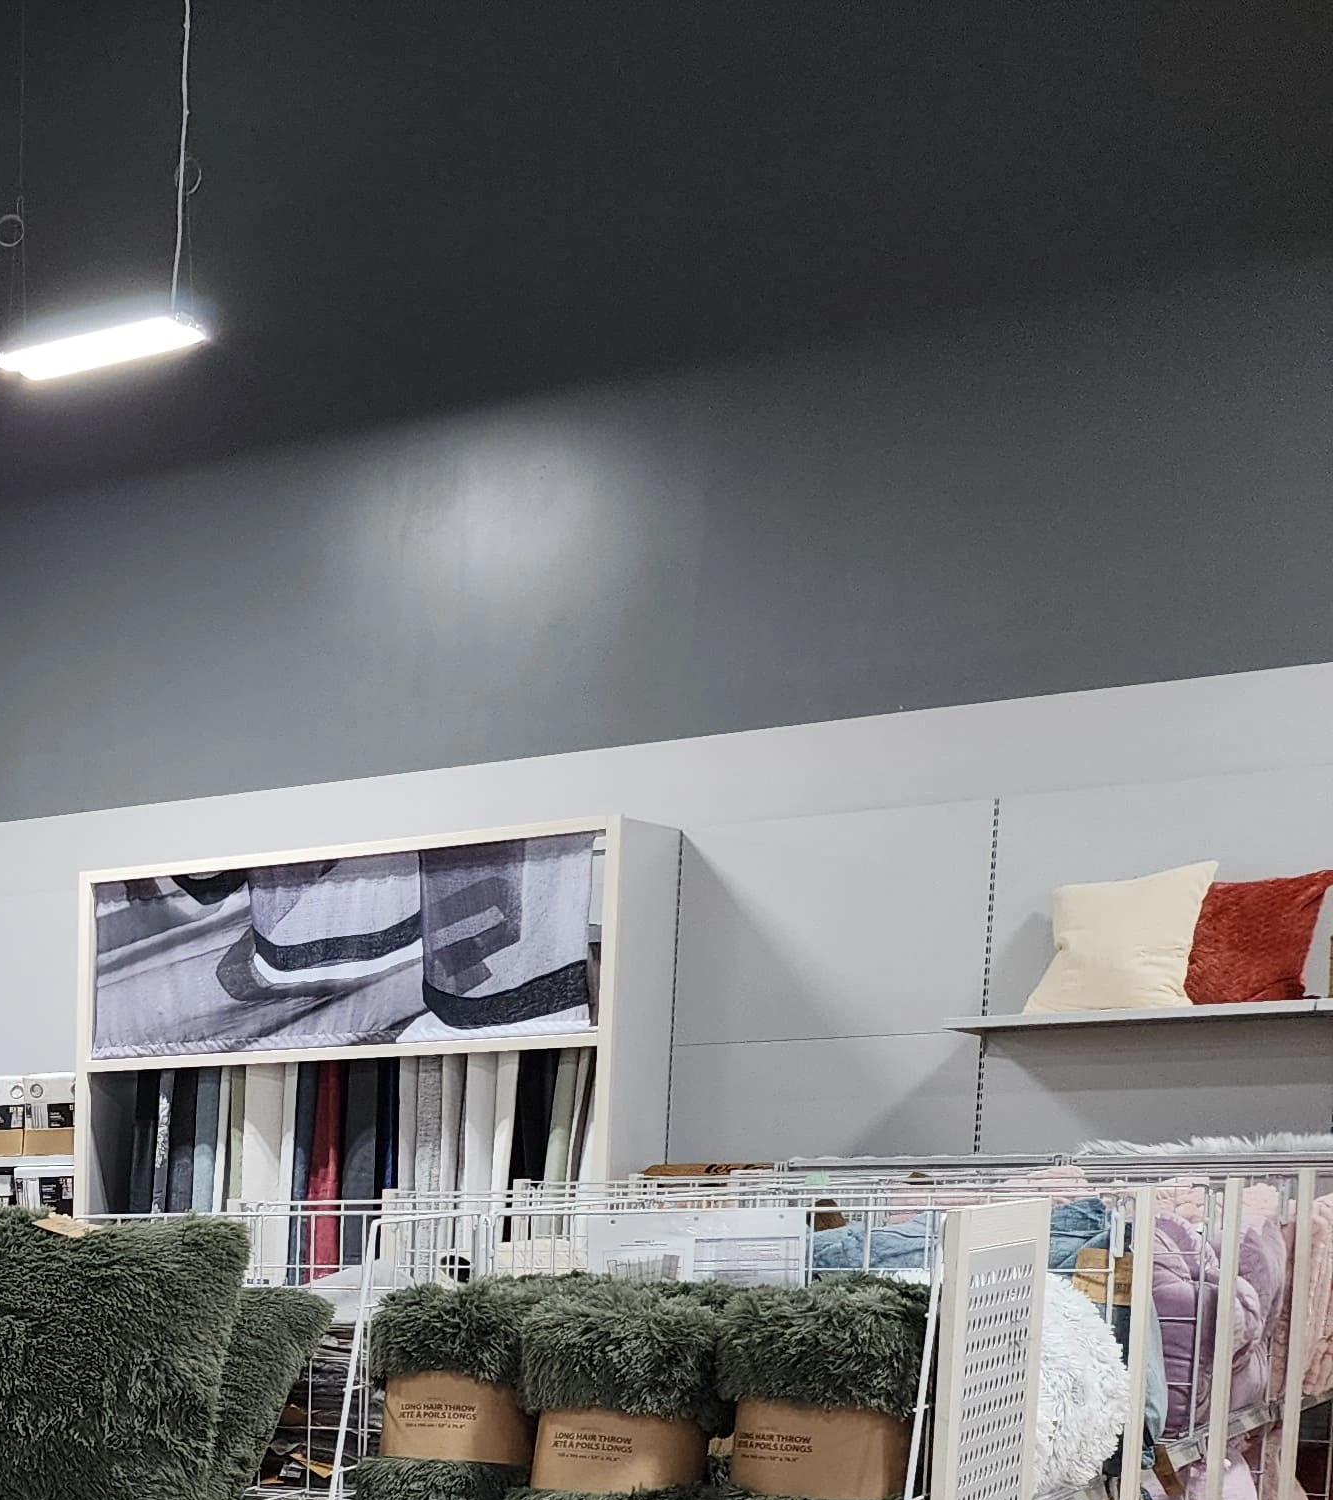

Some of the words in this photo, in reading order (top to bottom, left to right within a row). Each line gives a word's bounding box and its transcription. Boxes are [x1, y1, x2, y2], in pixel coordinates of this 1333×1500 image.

[400, 1403, 422, 1411] LONG
[423, 1403, 443, 1411] HAIR
[444, 1404, 477, 1413] THROW
[423, 1411, 446, 1420] POILS
[447, 1412, 477, 1421] LONGS
[554, 1431, 575, 1440] LONG
[576, 1433, 597, 1442] HAIR
[598, 1435, 633, 1445] THROW
[776, 1434, 812, 1444] THROW
[575, 1441, 600, 1451] POILS
[601, 1444, 633, 1454] LONGS
[779, 1444, 813, 1453] LONGS
